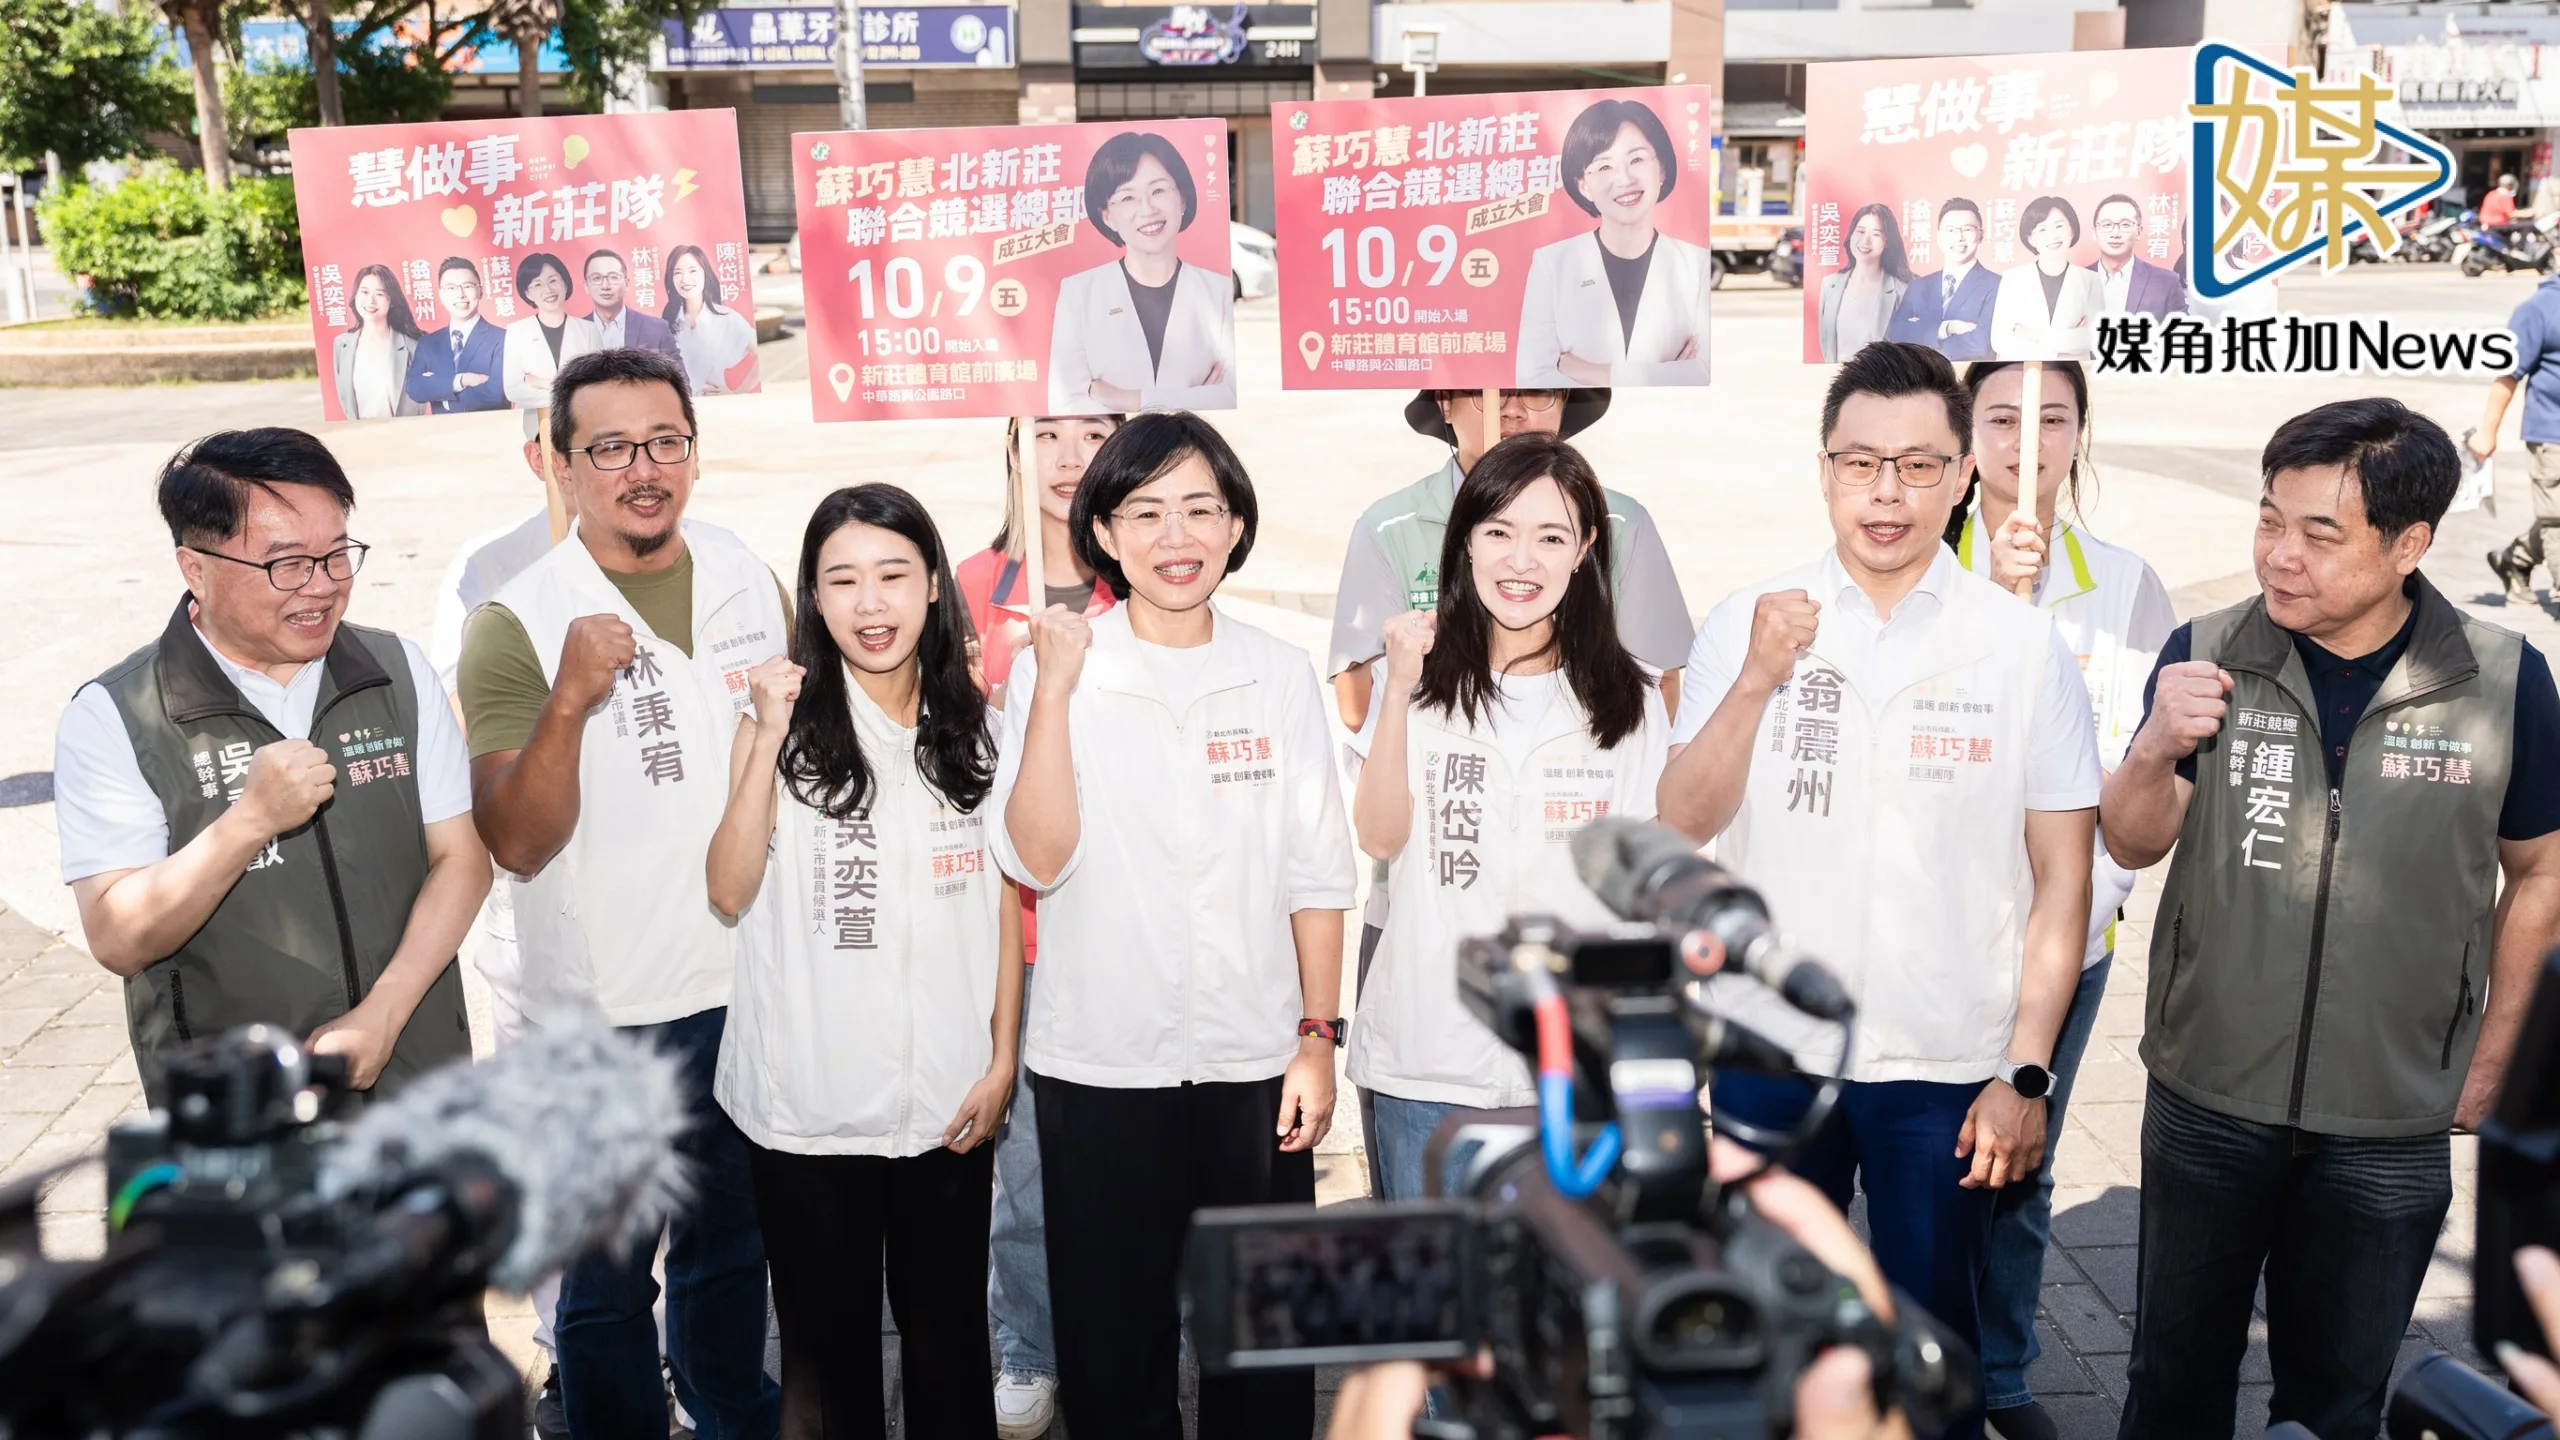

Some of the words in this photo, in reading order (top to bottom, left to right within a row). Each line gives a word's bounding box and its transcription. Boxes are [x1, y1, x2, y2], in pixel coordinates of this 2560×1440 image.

[751, 11, 919, 44] 晶華牙診所
[1265, 40, 1300, 58] 24H
[1859, 70, 2045, 145] 慧做事
[349, 134, 523, 208] 慧做事
[1292, 125, 1412, 176] 蘇巧慧
[1416, 111, 1541, 161] 北新莊
[2000, 118, 2188, 192] 新莊隊
[815, 156, 935, 208] 蘇巧慧
[940, 143, 1062, 192] 北新莊
[1321, 154, 1563, 216] 聯合競選總部
[492, 173, 665, 250] 新莊隊
[847, 185, 1087, 247] 聯合競選總部
[997, 223, 1070, 260] 成立大會
[1471, 192, 1546, 230] 成立大會
[1819, 202, 1840, 266] 吳奕萱
[490, 256, 516, 317] 蘇巧慧
[631, 246, 656, 308] 林秉宥
[715, 242, 739, 303] 陳岱吟
[1322, 224, 1458, 288] 10/9
[1469, 257, 1491, 279] 五
[321, 264, 348, 326] 吳奕萱
[410, 259, 436, 321] 翁震州
[848, 255, 986, 319] 10/9
[998, 287, 1020, 308] 五
[1328, 296, 1410, 325] 15:00
[1414, 309, 1468, 323] 開始入場
[858, 327, 940, 357] 15:00
[945, 338, 998, 353] 開始入場
[1331, 331, 1507, 355] 新莊體育館前廣場
[1331, 358, 1433, 372] 中華路與公園路口
[861, 360, 1038, 387] 新莊體育館前廣場
[609, 683, 629, 738] 北市議員
[624, 645, 684, 786] 林秉宥
[1913, 699, 1935, 712] 溫暖
[1938, 701, 1960, 713] 創新
[1962, 702, 1994, 715] 會做事
[2238, 710, 2298, 733] 新莊競總
[342, 743, 365, 757] 溫暖
[384, 736, 405, 749] 會做
[347, 752, 411, 786] 蘇巧慧
[1207, 736, 1273, 764] 蘇巧慧
[1787, 668, 1845, 817] 翁震州
[1910, 734, 1992, 762] 蘇巧慧
[2229, 739, 2248, 787] 總幹事
[2381, 752, 2472, 784] 蘇巧慧
[2384, 735, 2407, 748] 溫暖
[2410, 738, 2435, 750] 創新
[2438, 739, 2472, 753] 會做事
[192, 751, 219, 800] 總幹事
[2241, 741, 2295, 870] 鍾宏仁
[1440, 753, 1486, 891] 陳岱吟
[813, 825, 826, 935] 新北市議員候選人
[834, 808, 878, 950] 吳奕萱
